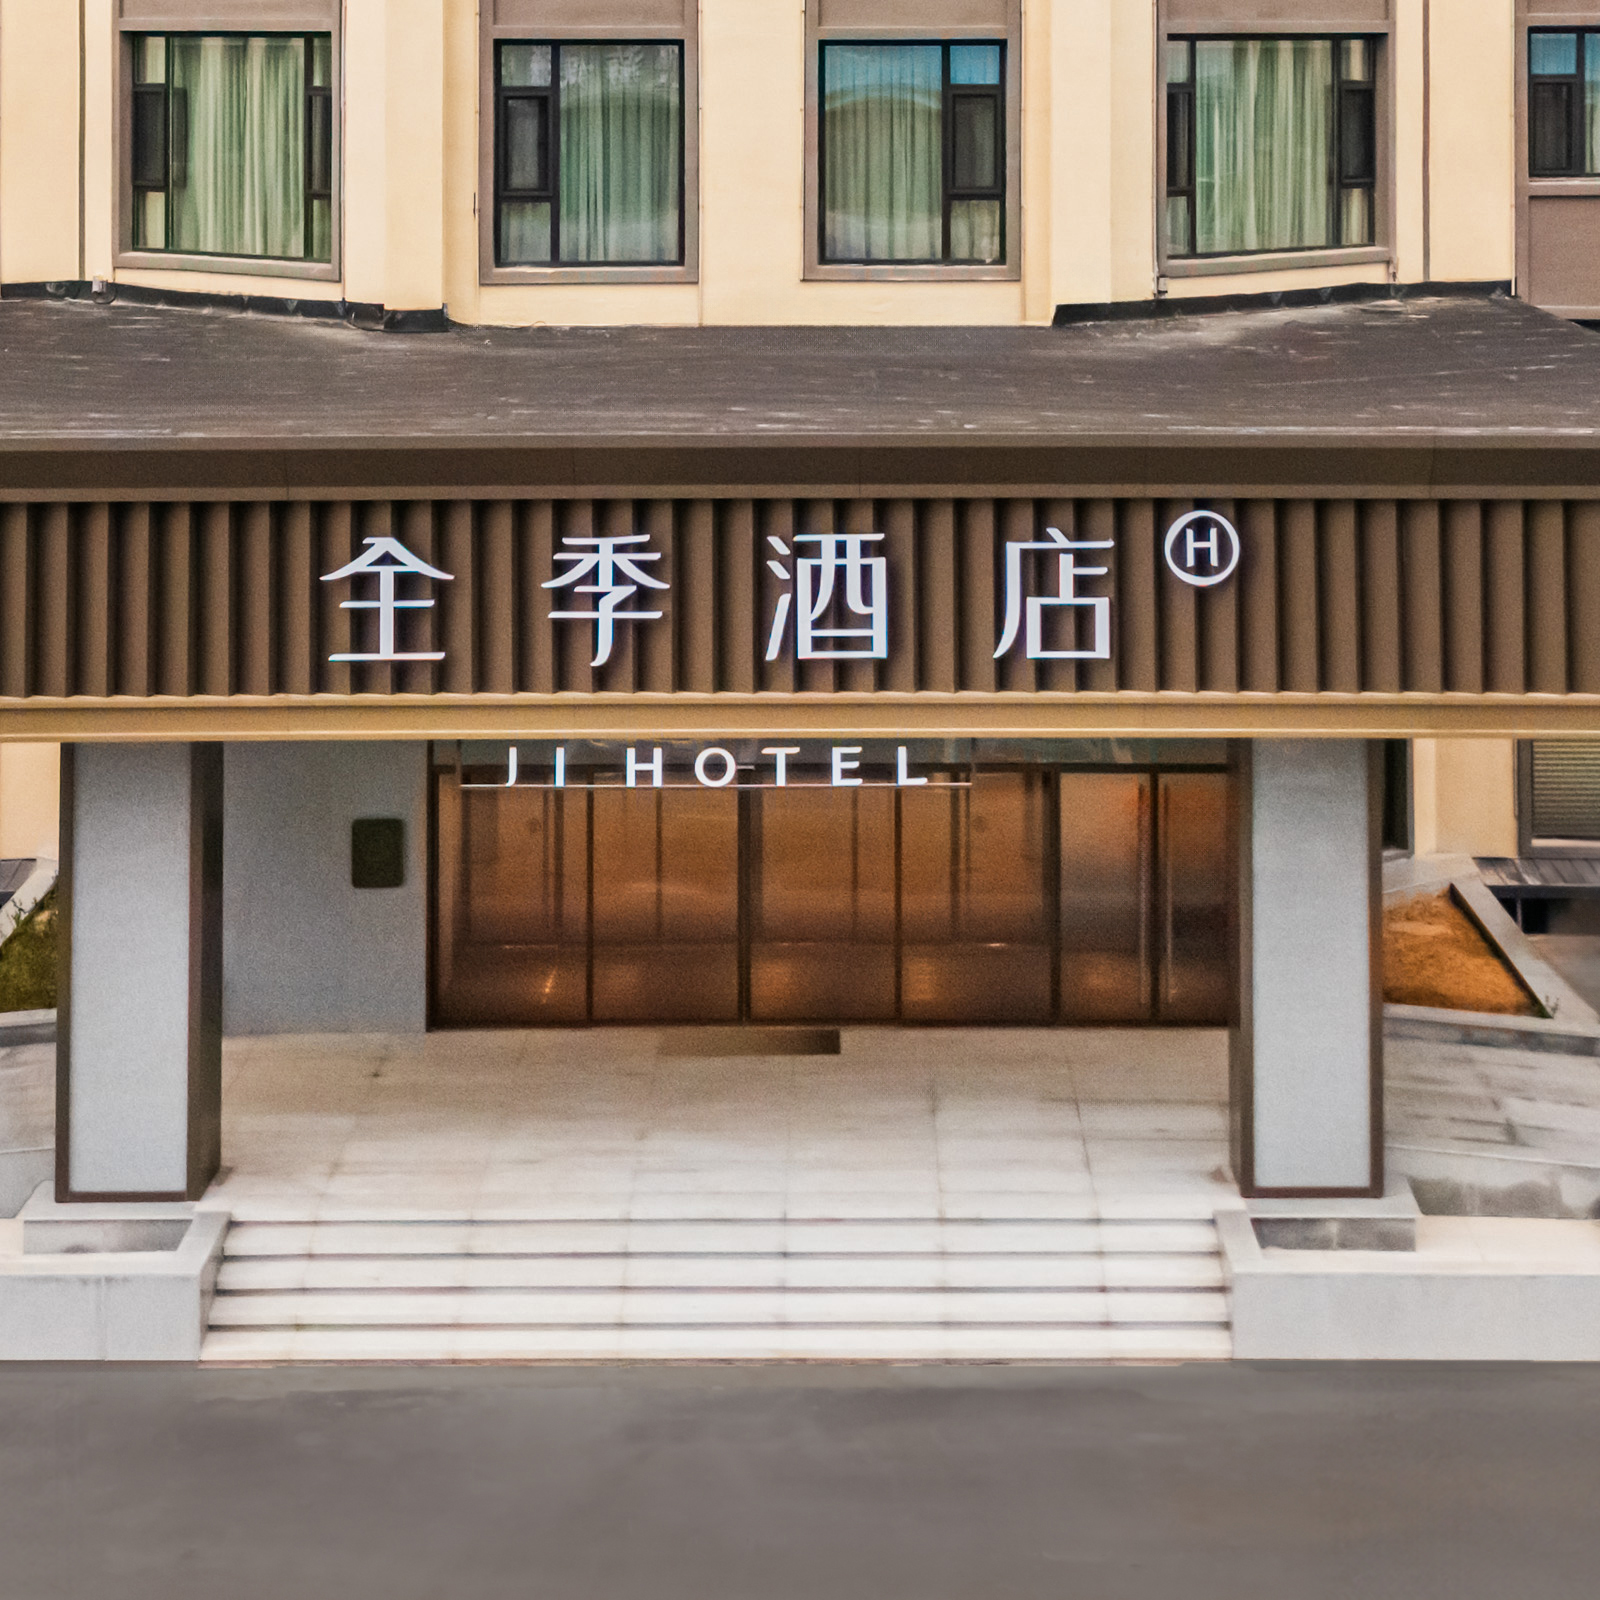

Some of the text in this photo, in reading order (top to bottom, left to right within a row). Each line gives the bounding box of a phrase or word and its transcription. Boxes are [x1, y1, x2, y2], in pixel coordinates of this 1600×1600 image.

[319, 528, 1114, 667] 全季酒店
[506, 746, 928, 787] JI HOTEL
